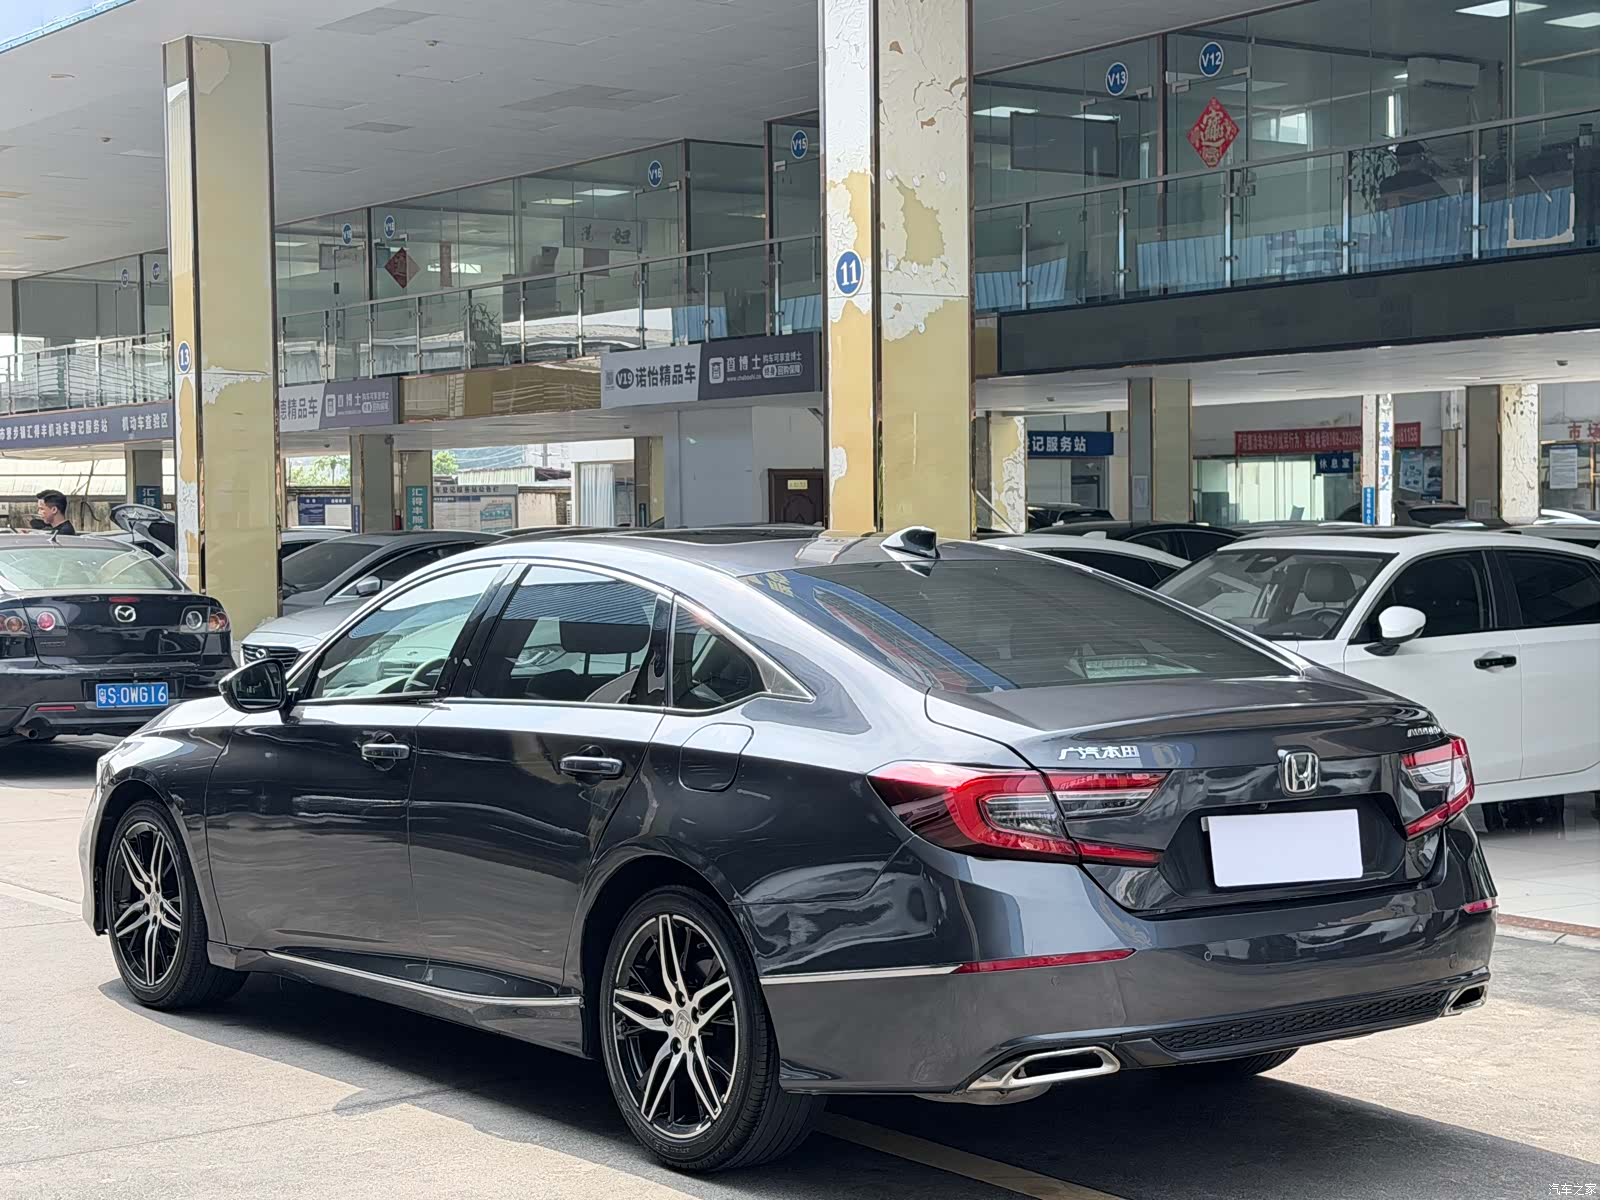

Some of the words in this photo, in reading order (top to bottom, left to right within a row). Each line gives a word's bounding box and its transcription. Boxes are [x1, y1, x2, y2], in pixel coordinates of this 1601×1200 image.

[1201, 51, 1222, 68] V12
[1107, 70, 1127, 88] V13
[792, 137, 807, 151] V15
[840, 259, 859, 287] 11
[180, 348, 190, 366] 13
[726, 354, 761, 373] 查博士
[635, 362, 696, 388] 诺怡精品车
[122, 412, 168, 431] 机动车查验区
[1027, 436, 1087, 453] 记服务站
[1319, 457, 1352, 470] 休息室
[1058, 745, 1140, 760] 广汽本田
